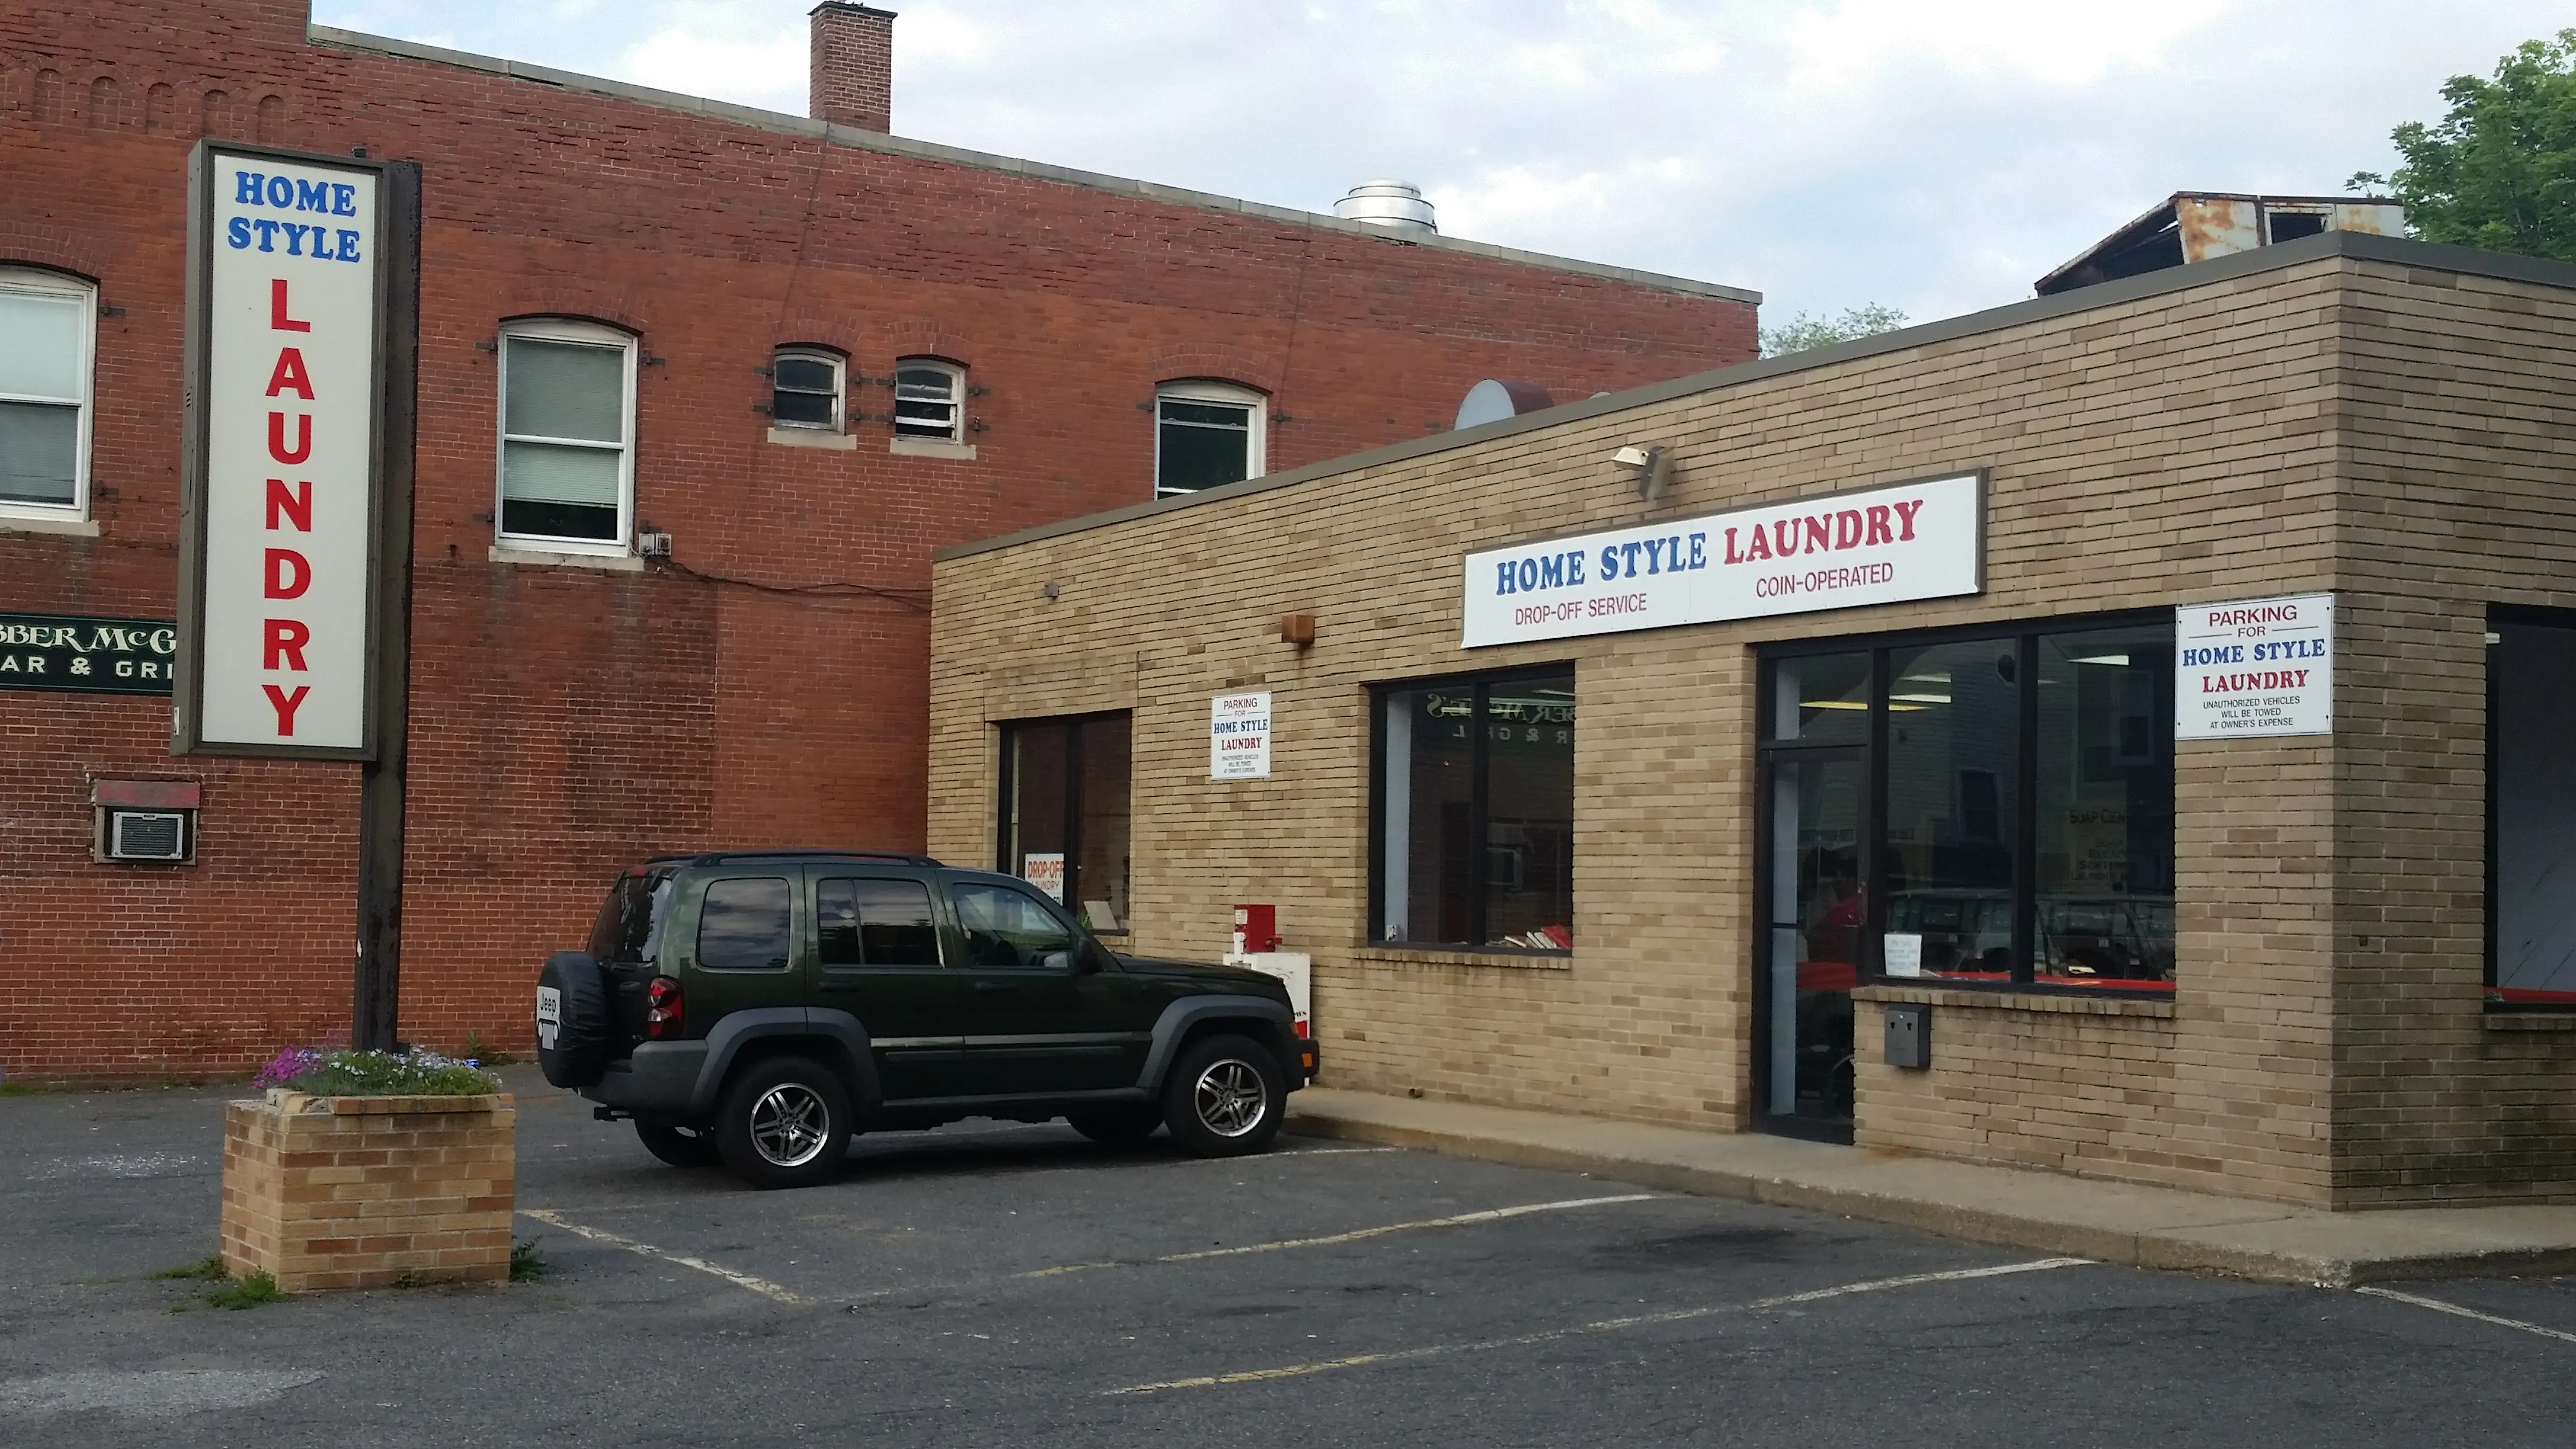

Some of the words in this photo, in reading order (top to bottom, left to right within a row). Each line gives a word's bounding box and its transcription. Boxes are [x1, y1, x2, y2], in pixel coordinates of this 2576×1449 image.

[235, 170, 356, 217] HOME
[228, 217, 360, 263] STYLE
[261, 279, 315, 737] LAUNDRY
[1496, 550, 1585, 596] HOME
[1600, 532, 1707, 581] STYLE
[1723, 499, 1923, 565] LAUNDRY
[1756, 562, 1894, 598] COIN-OPERATED
[1515, 601, 1582, 626] DROP-OFF
[1588, 593, 1647, 617] SERVICE
[2209, 605, 2297, 627] PARKING
[2238, 626, 2266, 638] FOR
[2183, 645, 2244, 666] HOME
[2254, 638, 2326, 661] STYLE
[70, 657, 92, 676] &
[2203, 669, 2310, 693] LAUNDRY
[1224, 698, 1257, 710] PARKING
[2203, 699, 2260, 709] UNAUTHORIZED
[2263, 696, 2301, 706] VEHICLES
[2221, 710, 2238, 718] WILL
[2254, 708, 2281, 717] TOWED
[1214, 722, 1237, 734] HOME
[1240, 719, 1268, 732] STYLE
[2258, 718, 2293, 726] EXPENSE
[1221, 737, 1262, 751] LAUNDRY
[1028, 861, 1064, 878] DROP-OFF
[540, 993, 556, 1017] Jeep
